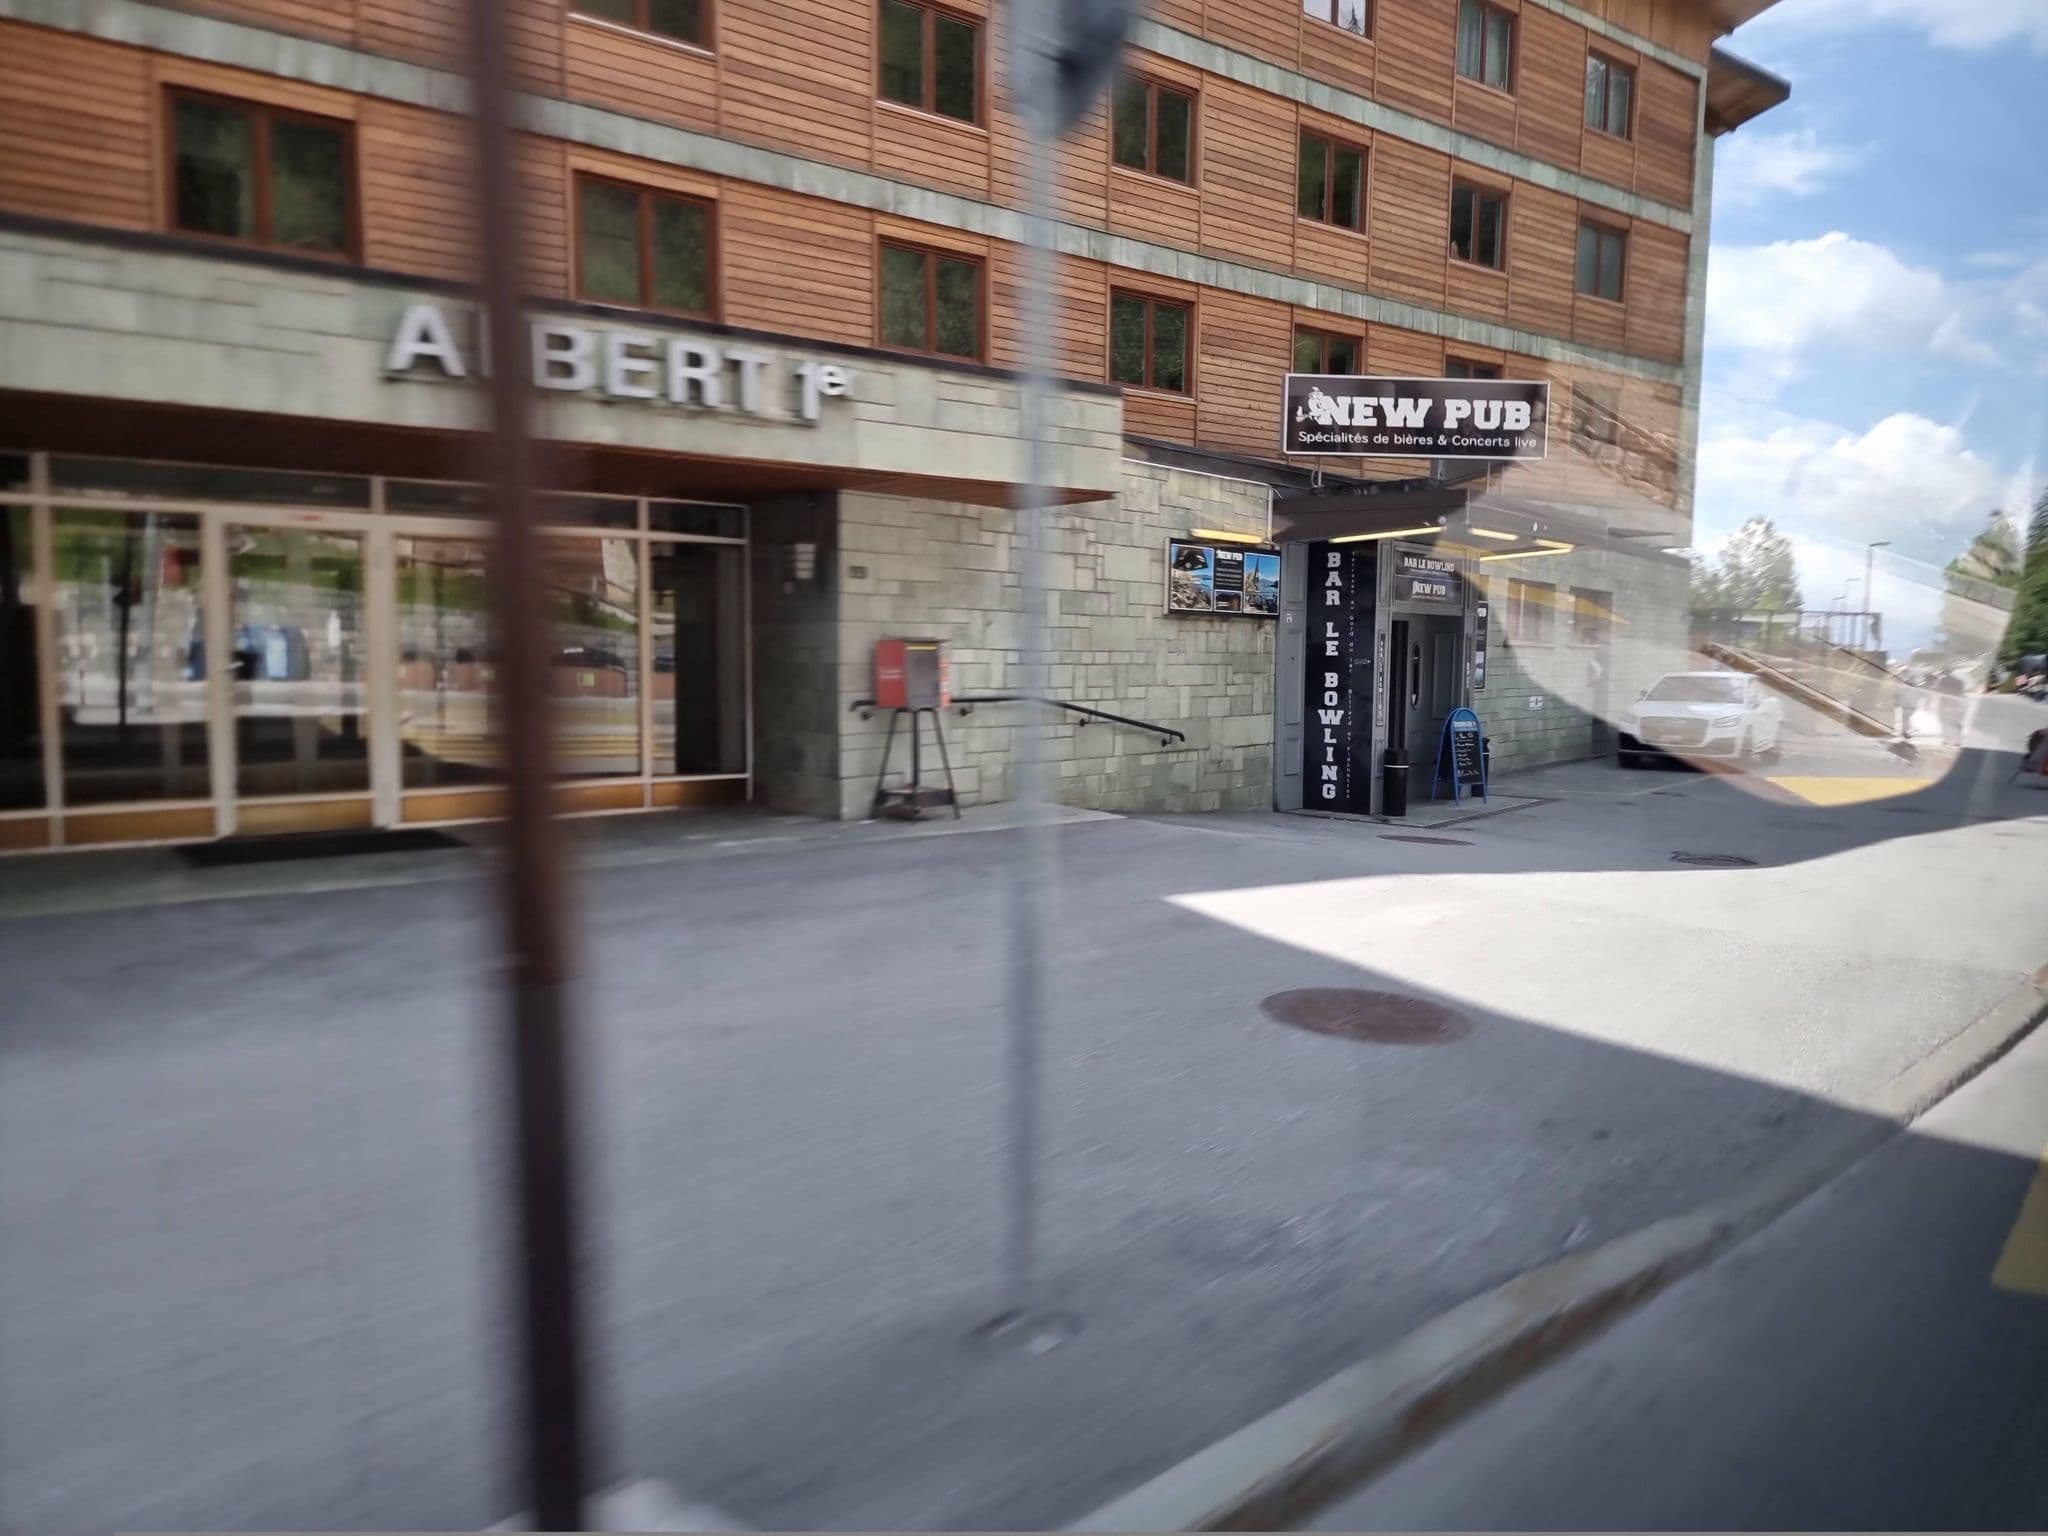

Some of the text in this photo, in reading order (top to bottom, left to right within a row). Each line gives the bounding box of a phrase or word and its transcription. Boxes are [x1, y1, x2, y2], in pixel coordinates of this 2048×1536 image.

[1315, 396, 1531, 431] NEW PUB
[1297, 431, 1537, 448] Spécialités de bières & Concerts live
[1404, 556, 1418, 569] BAR
[1317, 552, 1345, 799] BAR LE BOWLING
